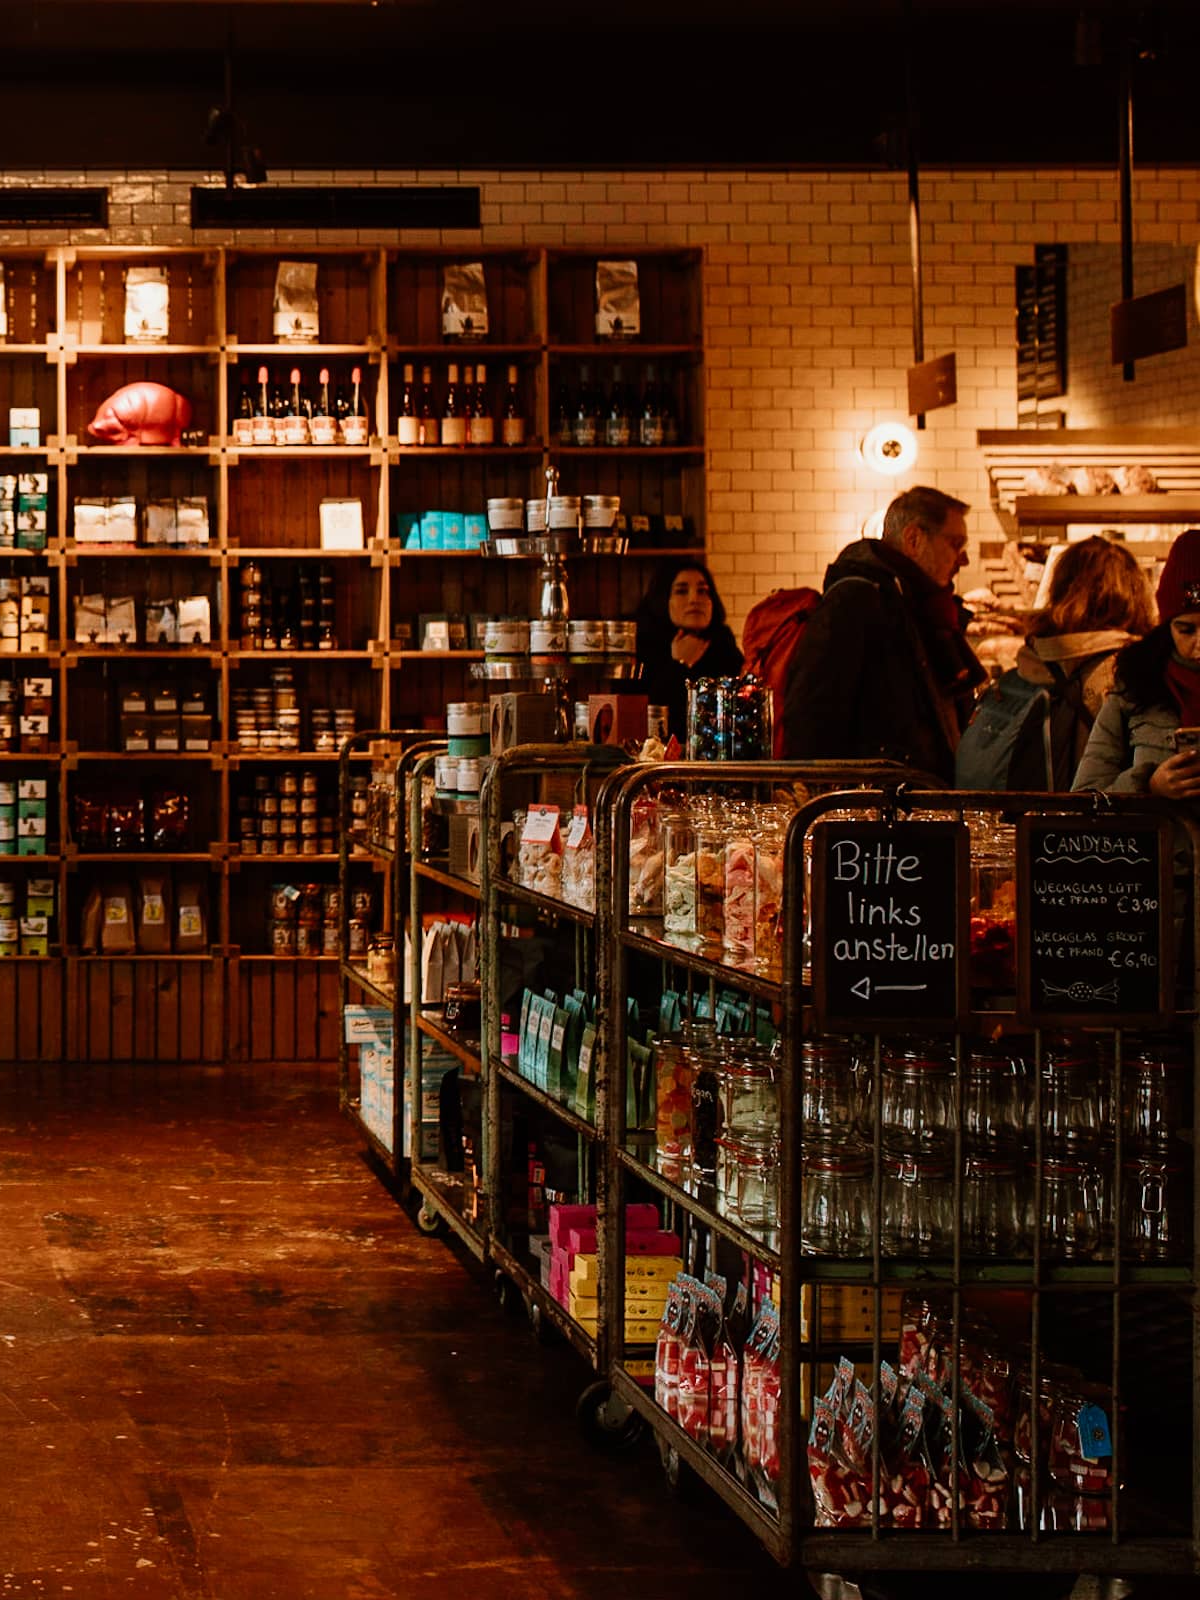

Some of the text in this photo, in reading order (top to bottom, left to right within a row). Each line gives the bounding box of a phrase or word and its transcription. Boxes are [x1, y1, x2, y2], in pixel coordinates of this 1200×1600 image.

[1043, 833, 1139, 854] CANDYBAR
[831, 840, 923, 885] Bitte
[1034, 880, 1104, 895] WECKGLAS
[848, 891, 922, 926] links
[1069, 896, 1108, 905] PFAND
[833, 932, 955, 961] anstellen
[1069, 947, 1104, 958] PFAND
